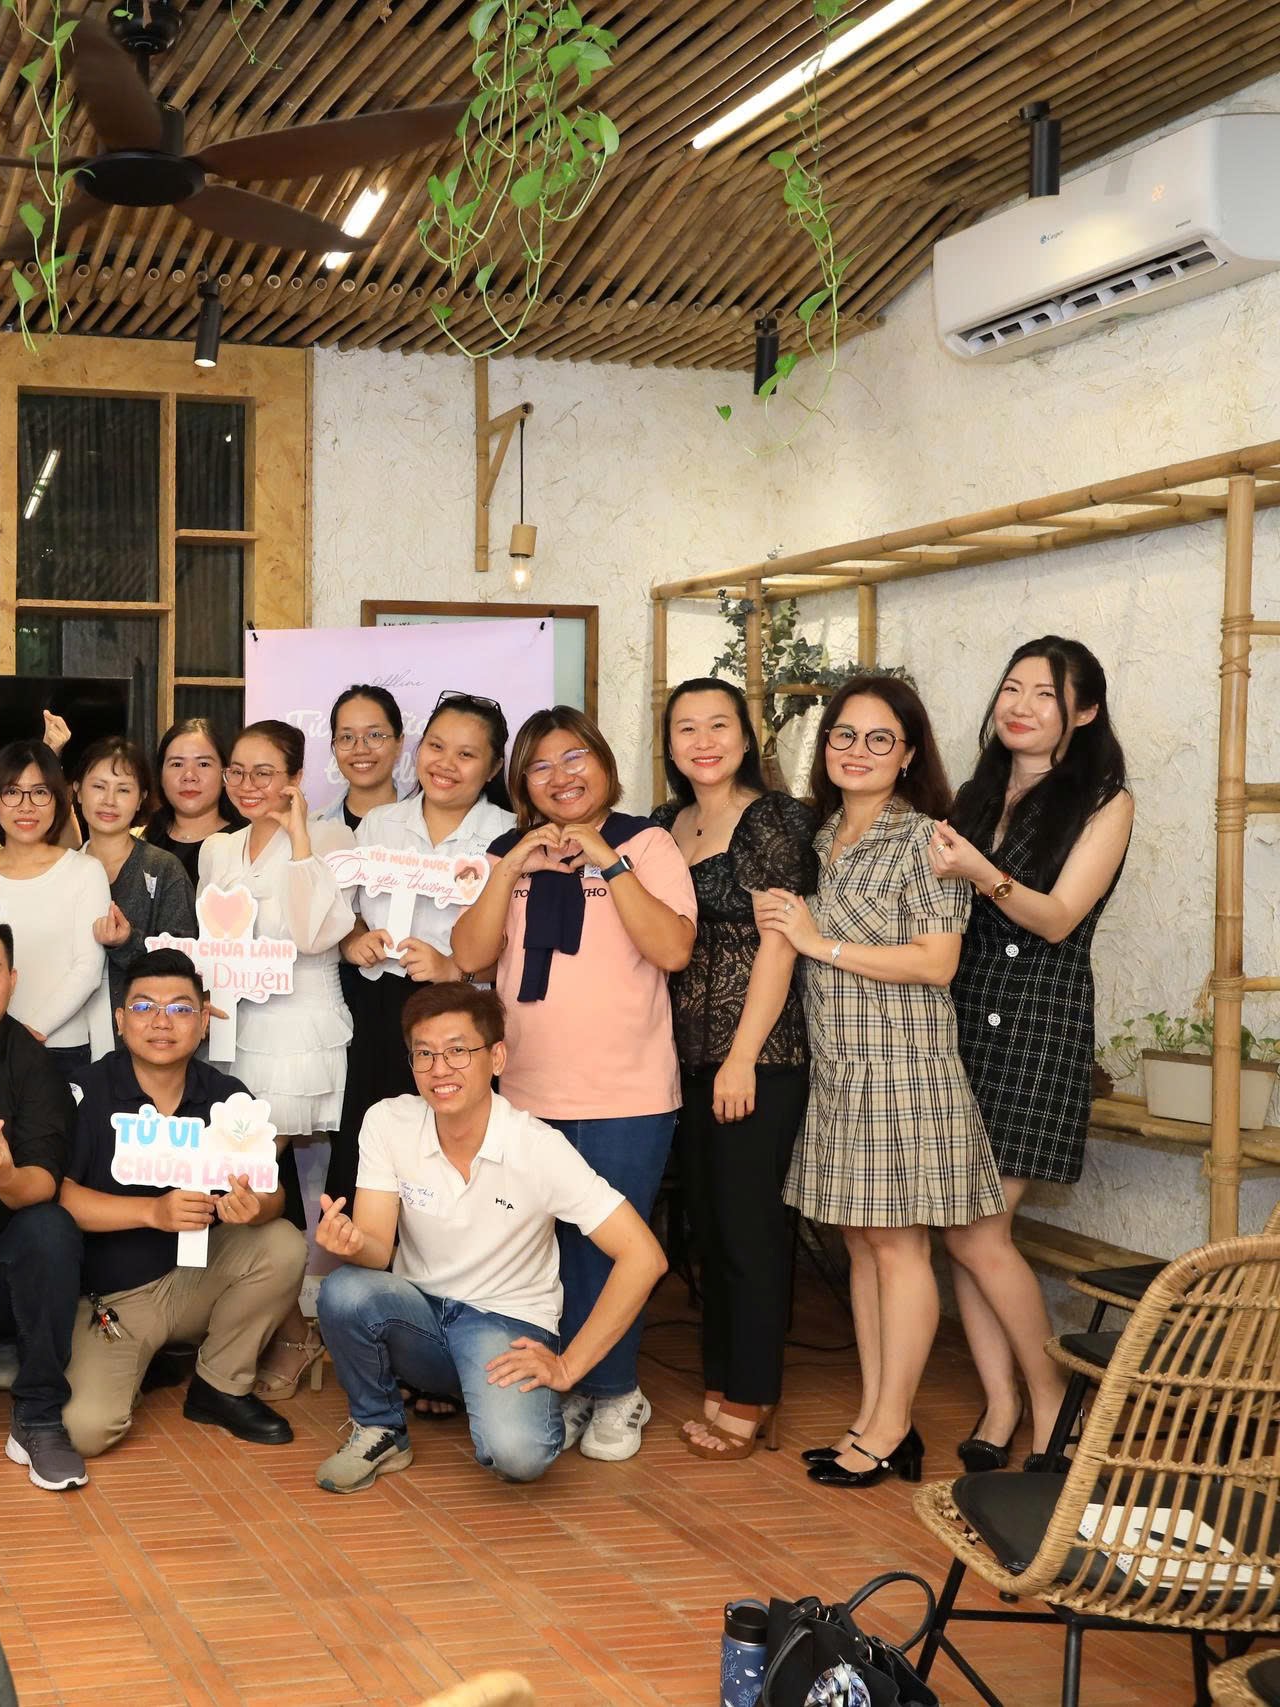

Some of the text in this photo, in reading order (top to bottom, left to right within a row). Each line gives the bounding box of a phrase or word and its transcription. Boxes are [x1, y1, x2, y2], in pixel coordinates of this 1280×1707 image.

[198, 939, 244, 958] CHỮA
[250, 940, 293, 959] LÀNH
[213, 963, 289, 999] Duyên
[116, 1109, 160, 1145] TỬ
[115, 1153, 193, 1185] CHỮA
